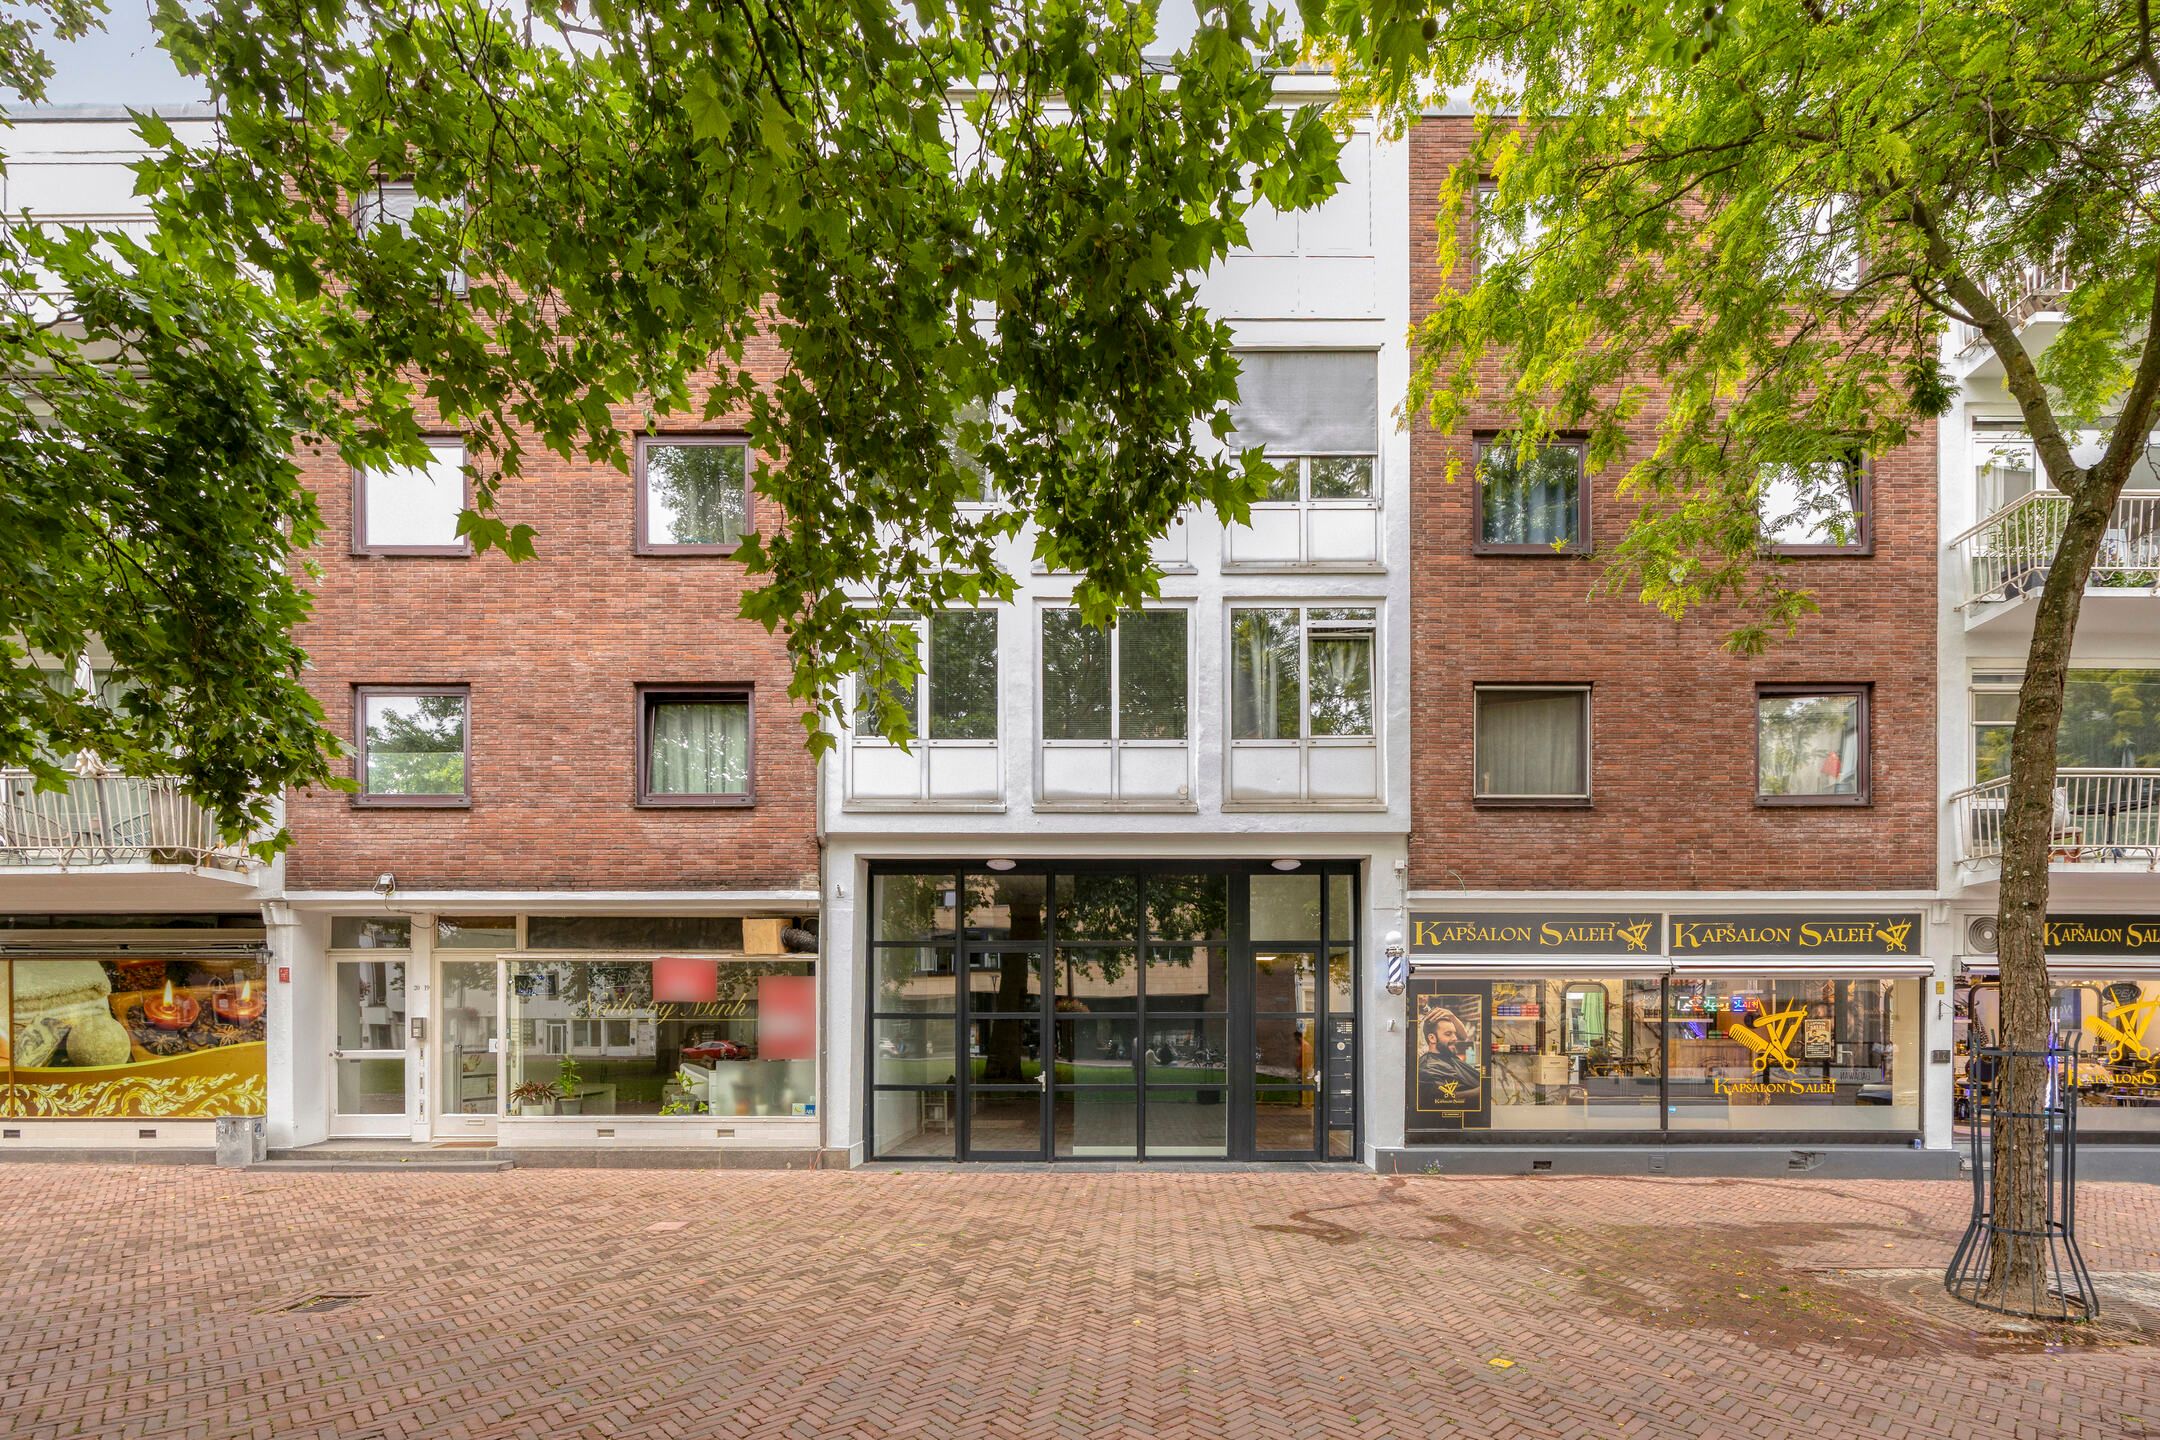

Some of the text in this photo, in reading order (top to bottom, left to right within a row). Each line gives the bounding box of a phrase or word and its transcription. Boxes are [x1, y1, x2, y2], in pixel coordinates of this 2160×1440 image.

[1413, 921, 1615, 946] KAPSALON SALEH
[1673, 922, 1874, 948] KAPSALON SALEH
[2044, 923, 2122, 946] KAPSALON
[571, 991, 638, 1018] Nails
[1714, 1078, 1836, 1095] KAPSALON SALEH
